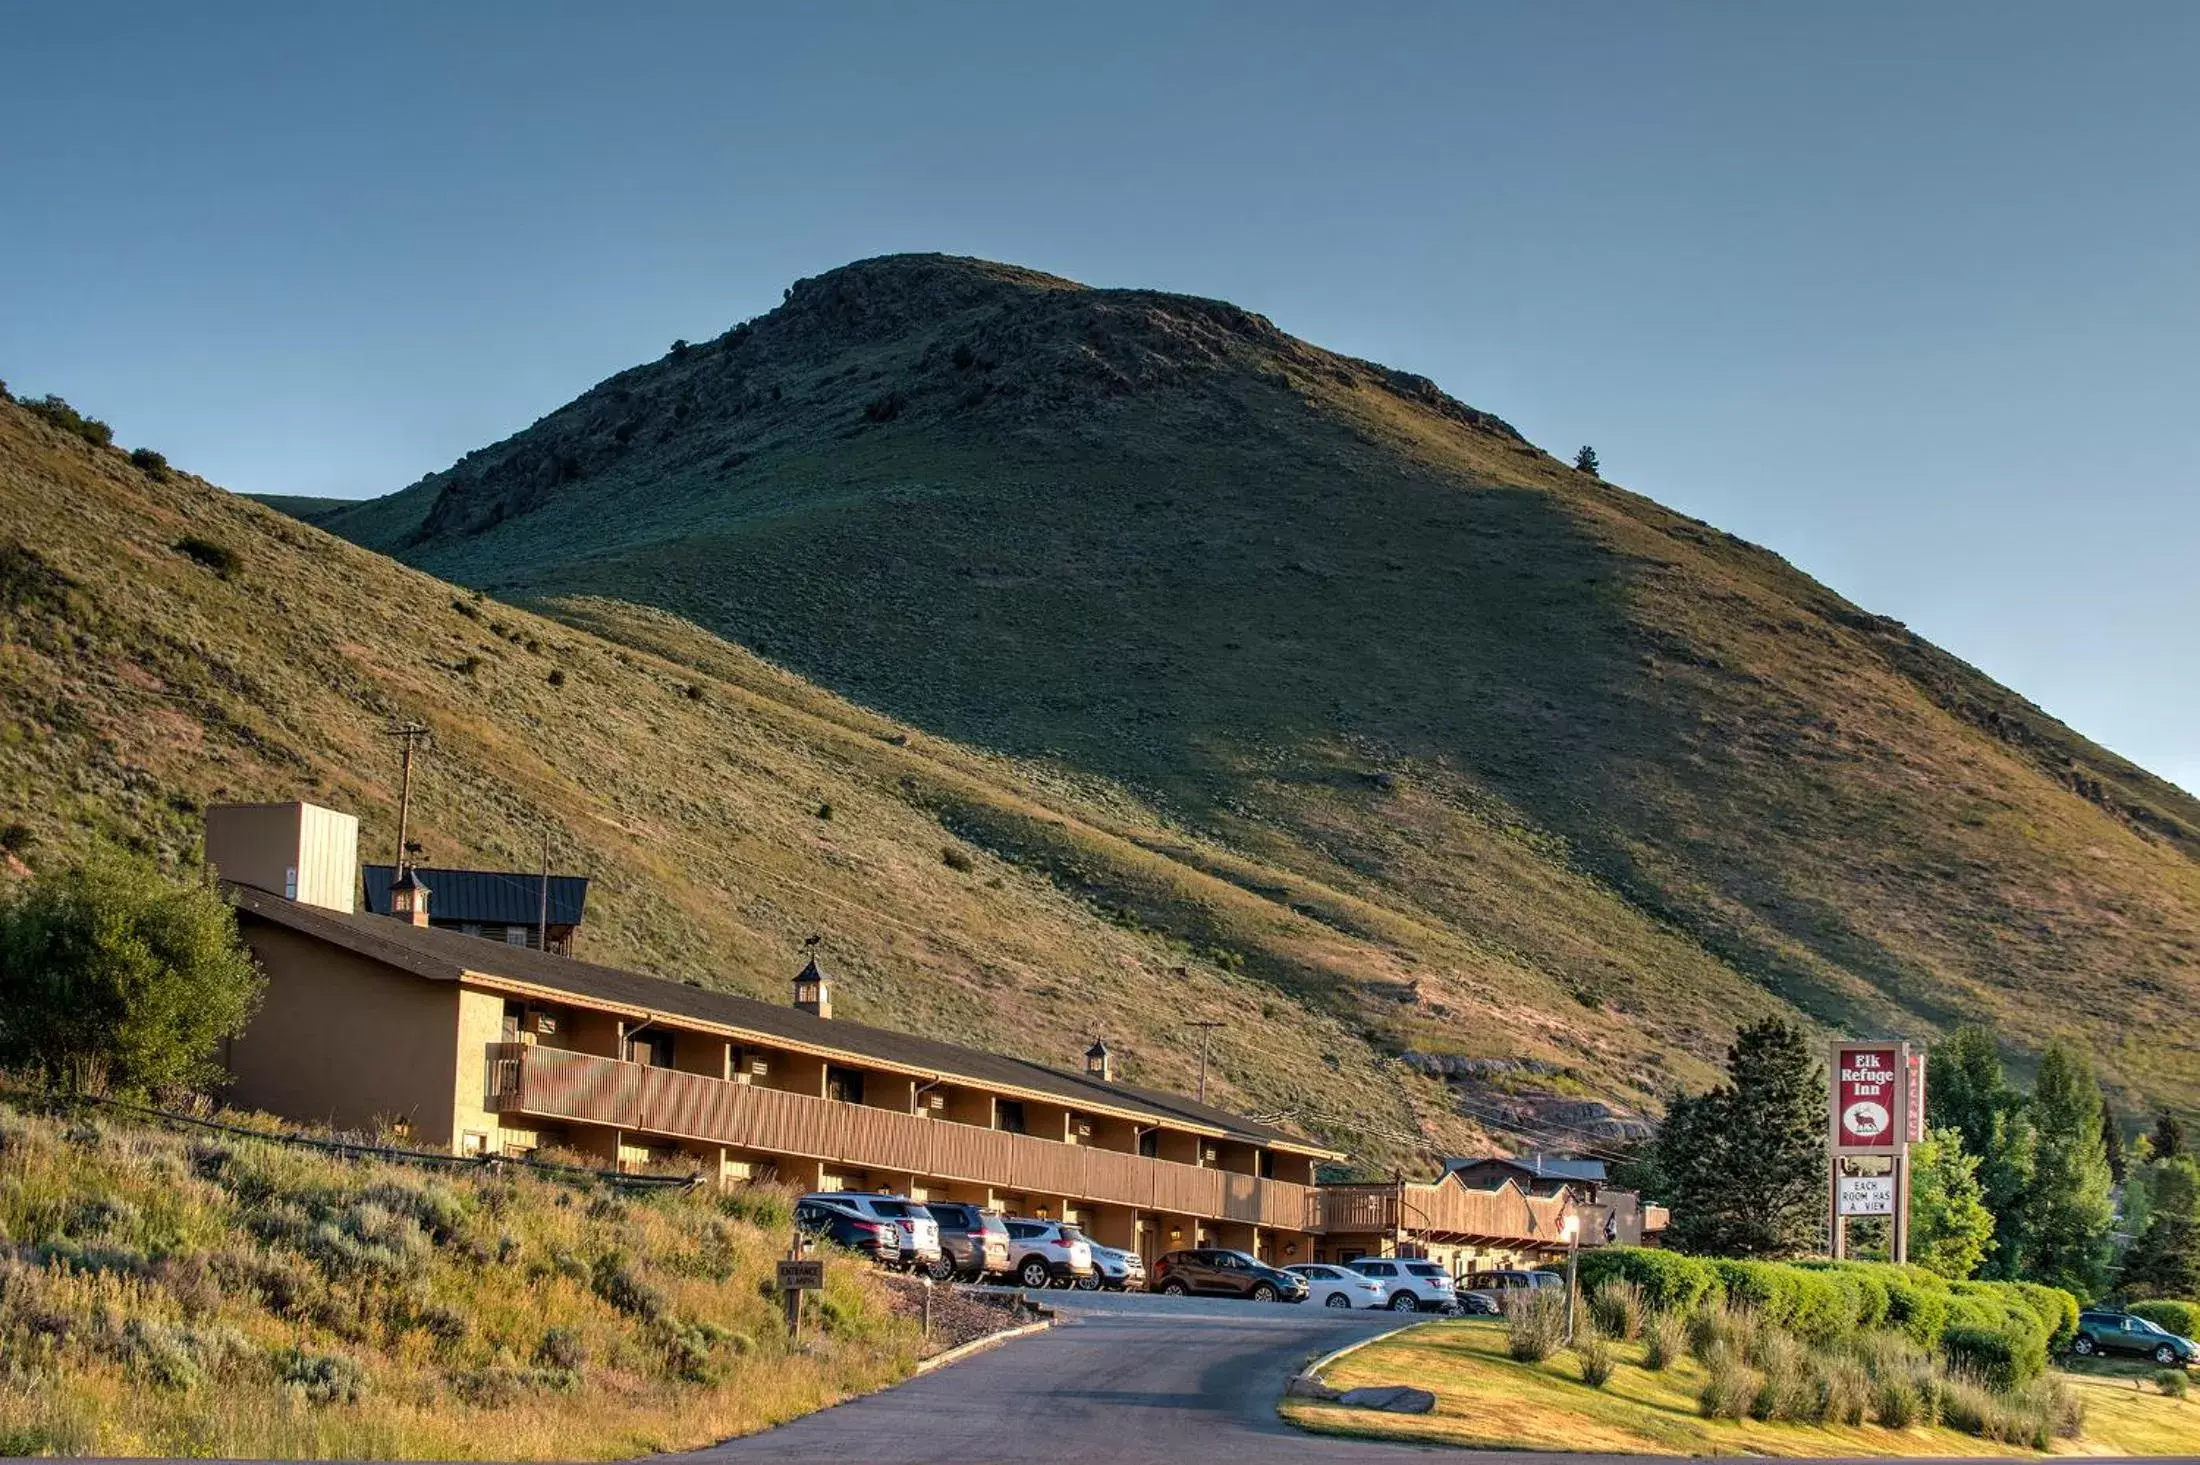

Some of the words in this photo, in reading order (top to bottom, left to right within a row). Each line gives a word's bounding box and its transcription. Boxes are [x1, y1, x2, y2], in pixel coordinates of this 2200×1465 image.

[1855, 1054, 1880, 1067] Elk
[1842, 1069, 1893, 1084] Refuge
[1854, 1083, 1880, 1095] Inn
[1854, 1181, 1877, 1190] EACH
[1843, 1191, 1868, 1201] ROOM
[1872, 1191, 1891, 1201] HAS
[1850, 1202, 1856, 1211] A
[1865, 1202, 1884, 1211] VIEW
